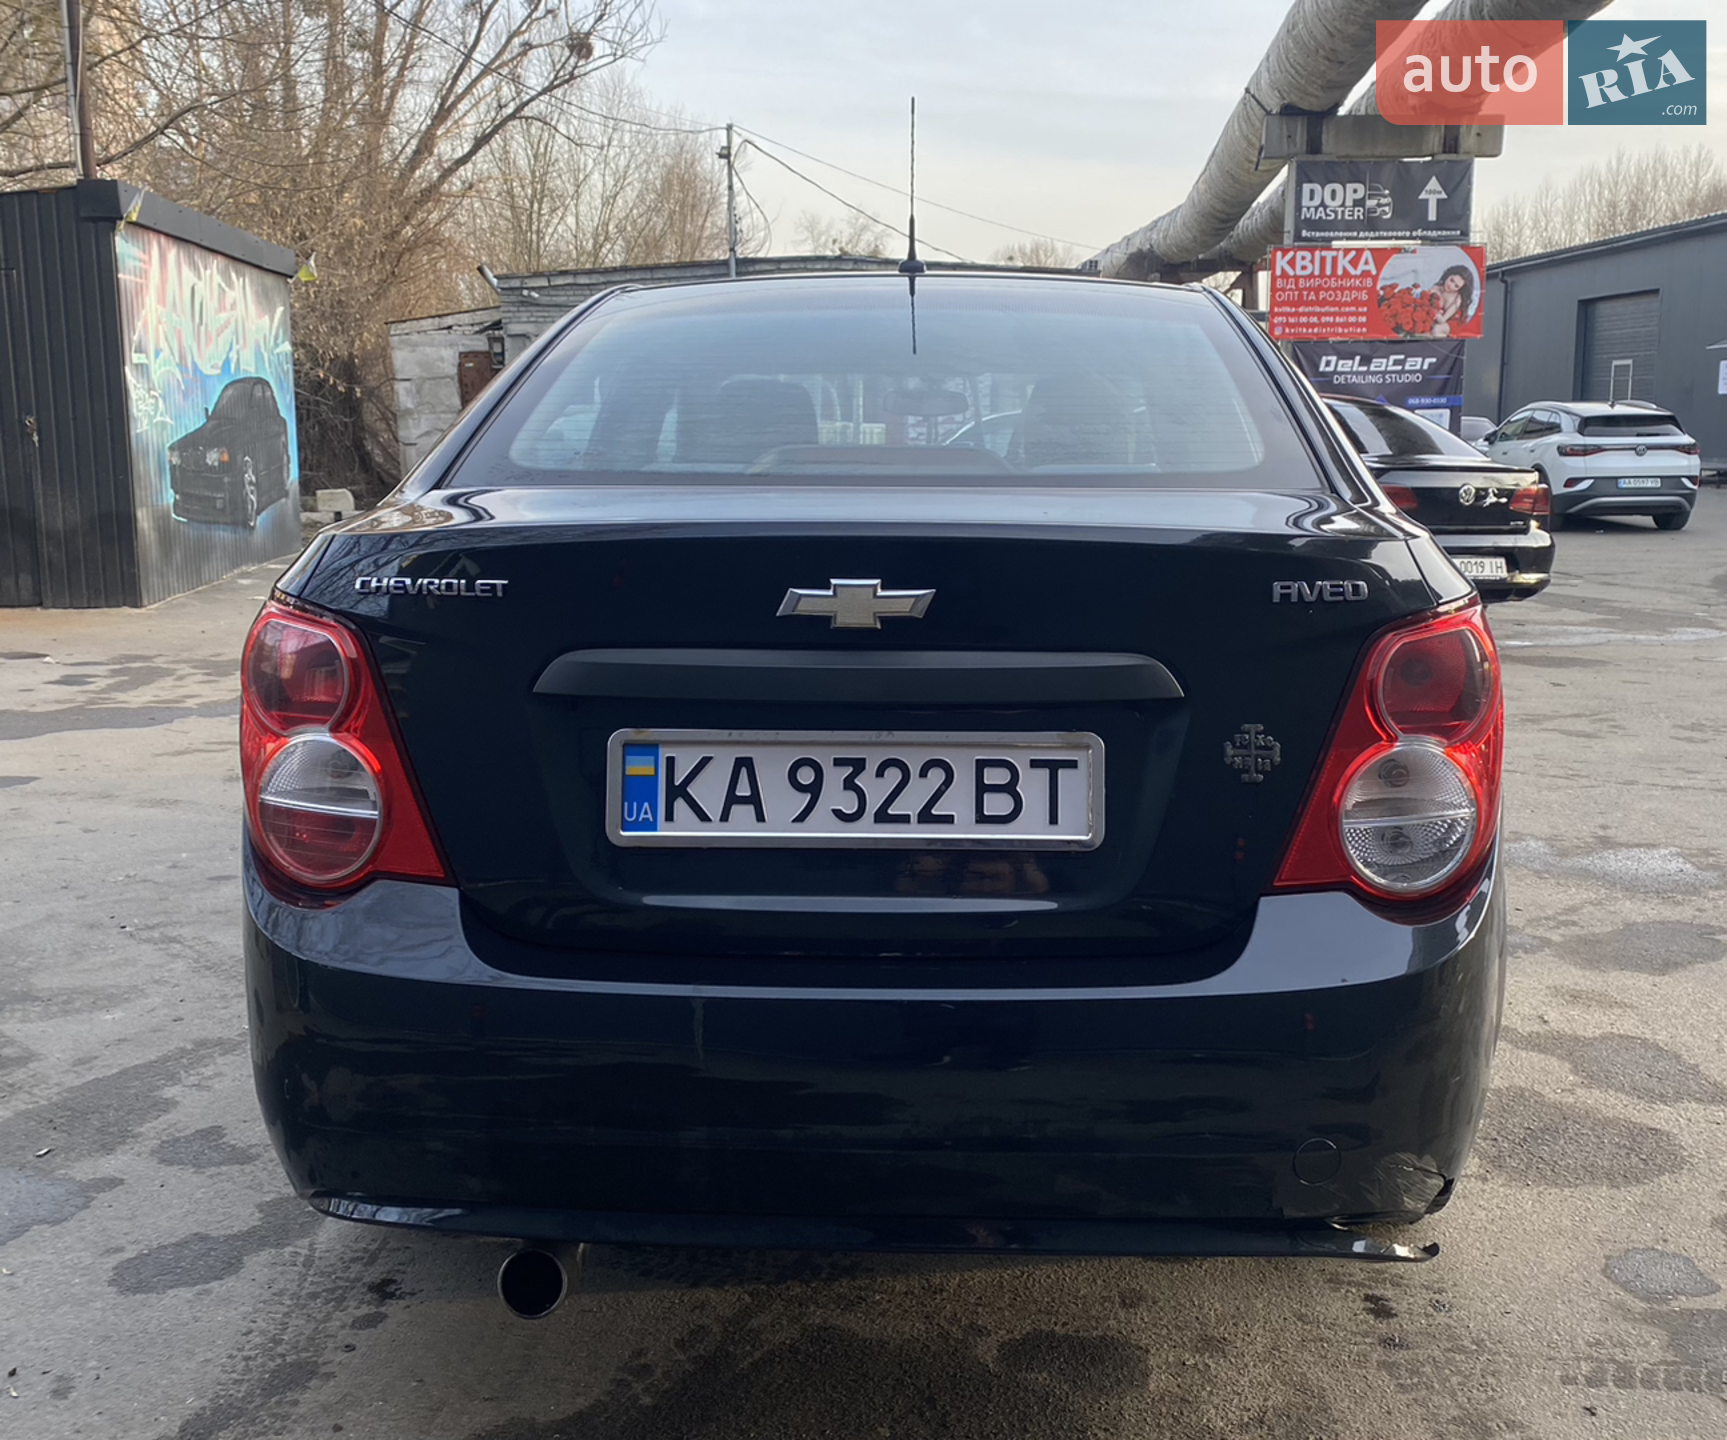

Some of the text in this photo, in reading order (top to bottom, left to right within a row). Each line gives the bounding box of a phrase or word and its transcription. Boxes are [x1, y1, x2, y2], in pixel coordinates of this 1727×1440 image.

[1301, 183, 1366, 207] DOP
[1301, 206, 1364, 220] MASTER
[1275, 249, 1377, 276] КВІТКА
[1276, 277, 1374, 290] ВІД ВИРОБНИКІВ
[1275, 290, 1369, 302] ОПТ ТА РОЗДРІБ
[1319, 354, 1437, 372] DeLaCar
[1333, 373, 1423, 384] DETAILING STUDIO
[1460, 560, 1486, 574] 0019
[354, 576, 509, 597] CHEVROLET
[1272, 580, 1369, 603] AVEO
[664, 755, 1079, 825] KA 9322 BT
[623, 801, 654, 822] UA
